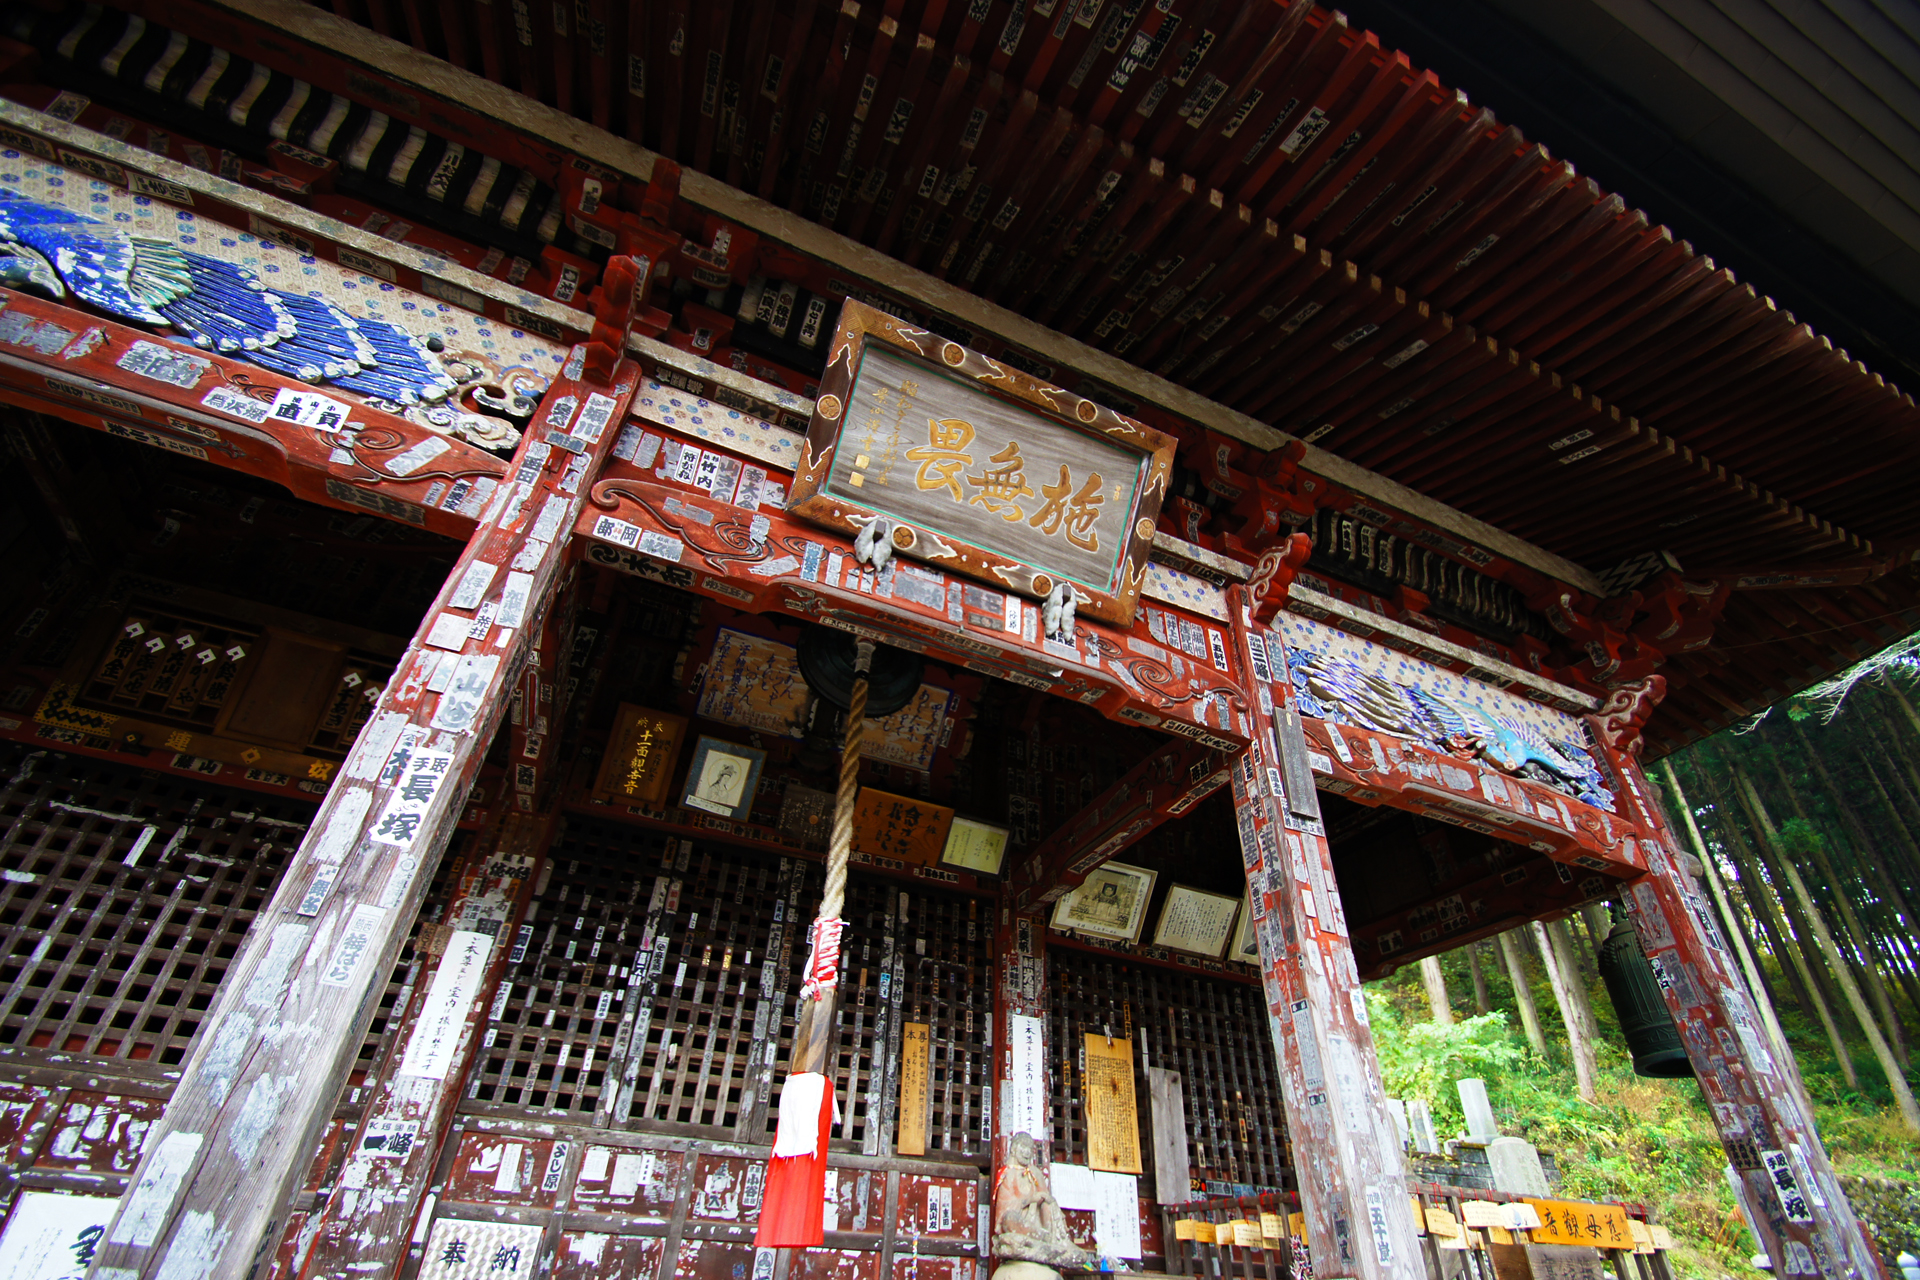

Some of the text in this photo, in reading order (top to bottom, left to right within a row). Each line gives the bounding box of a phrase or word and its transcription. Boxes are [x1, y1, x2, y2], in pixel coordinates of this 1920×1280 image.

[697, 461, 717, 488] 竹内
[378, 774, 438, 842] 長塚
[1773, 1169, 1809, 1219] 長塚
[441, 1239, 521, 1272] 奉納
